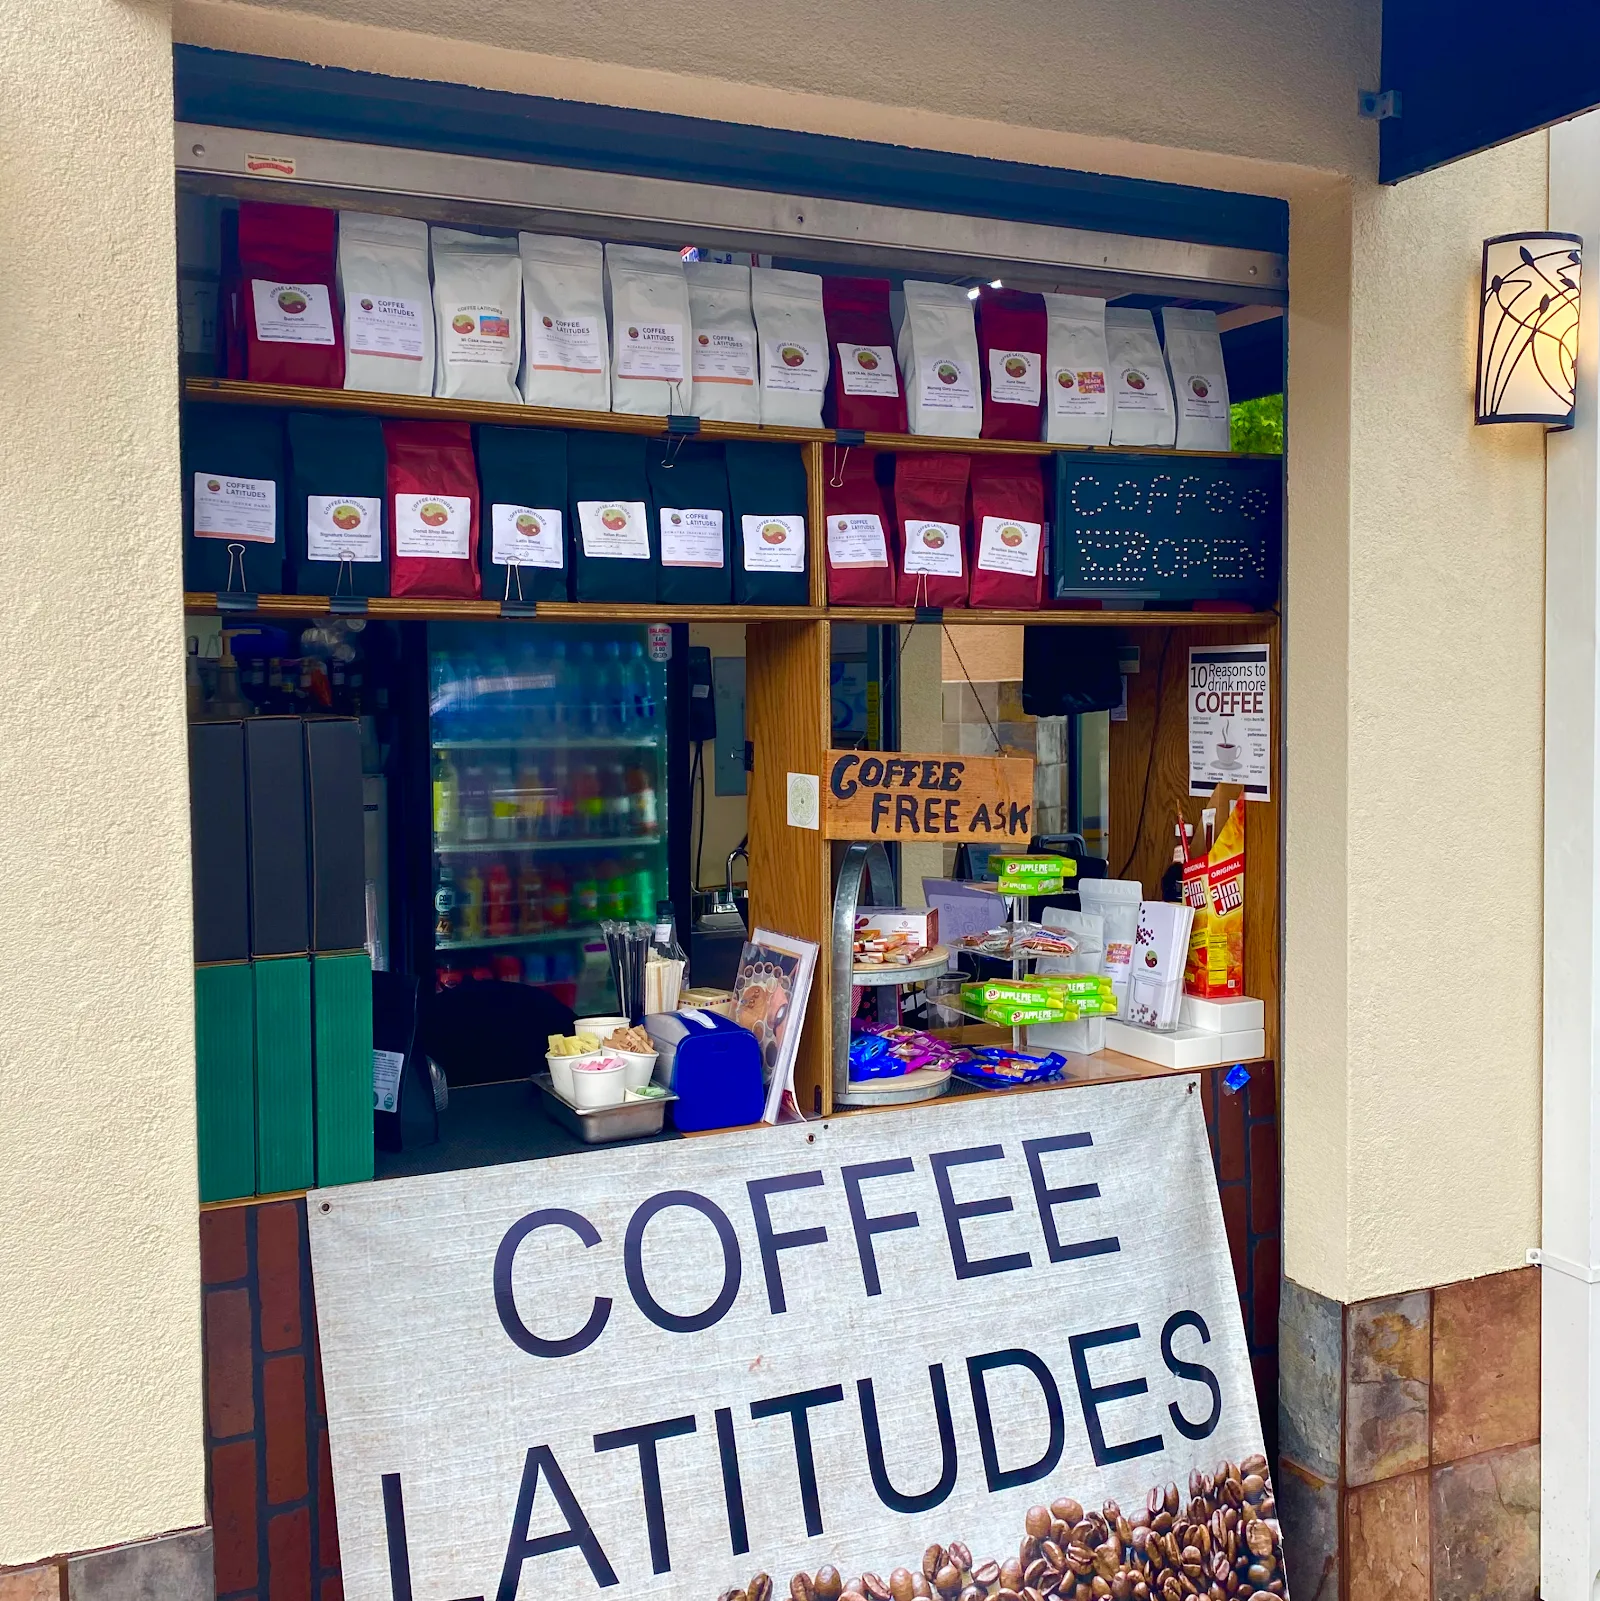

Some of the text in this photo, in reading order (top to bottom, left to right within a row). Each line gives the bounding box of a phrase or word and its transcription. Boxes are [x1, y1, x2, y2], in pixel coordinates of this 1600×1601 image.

[270, 286, 284, 298] COFFEE
[378, 300, 404, 308] COFFEE
[378, 307, 415, 317] LATITUDES
[999, 354, 1011, 365] COFFEE
[226, 482, 255, 490] COFFEE
[226, 489, 266, 498] LATITUDES
[323, 499, 368, 516] COFFEE LATITUDES
[412, 497, 454, 514] COFFEE LATITUDES
[508, 509, 547, 526] COFFEE LATITUDES
[756, 519, 792, 533] COFFEE LATITUDES
[917, 524, 931, 536] COFFEE
[1151, 538, 1266, 579] OPEN
[1190, 663, 1266, 688] 10 Reasons to
[1208, 677, 1266, 692] drink more
[1195, 691, 1264, 713] COFFEE
[831, 754, 965, 800] COFFEE
[871, 792, 1030, 836] FREE ASK
[1020, 863, 1038, 871] APPLE
[1184, 862, 1206, 874] ORIGINAL
[1211, 861, 1241, 878] ORIGINAL
[1077, 982, 1085, 990] PIE
[1000, 992, 1021, 1000] APPLE
[1024, 1011, 1044, 1019] APPLE
[493, 1132, 1120, 1358] COFFEE
[381, 1310, 1223, 1601] LATITUDES
